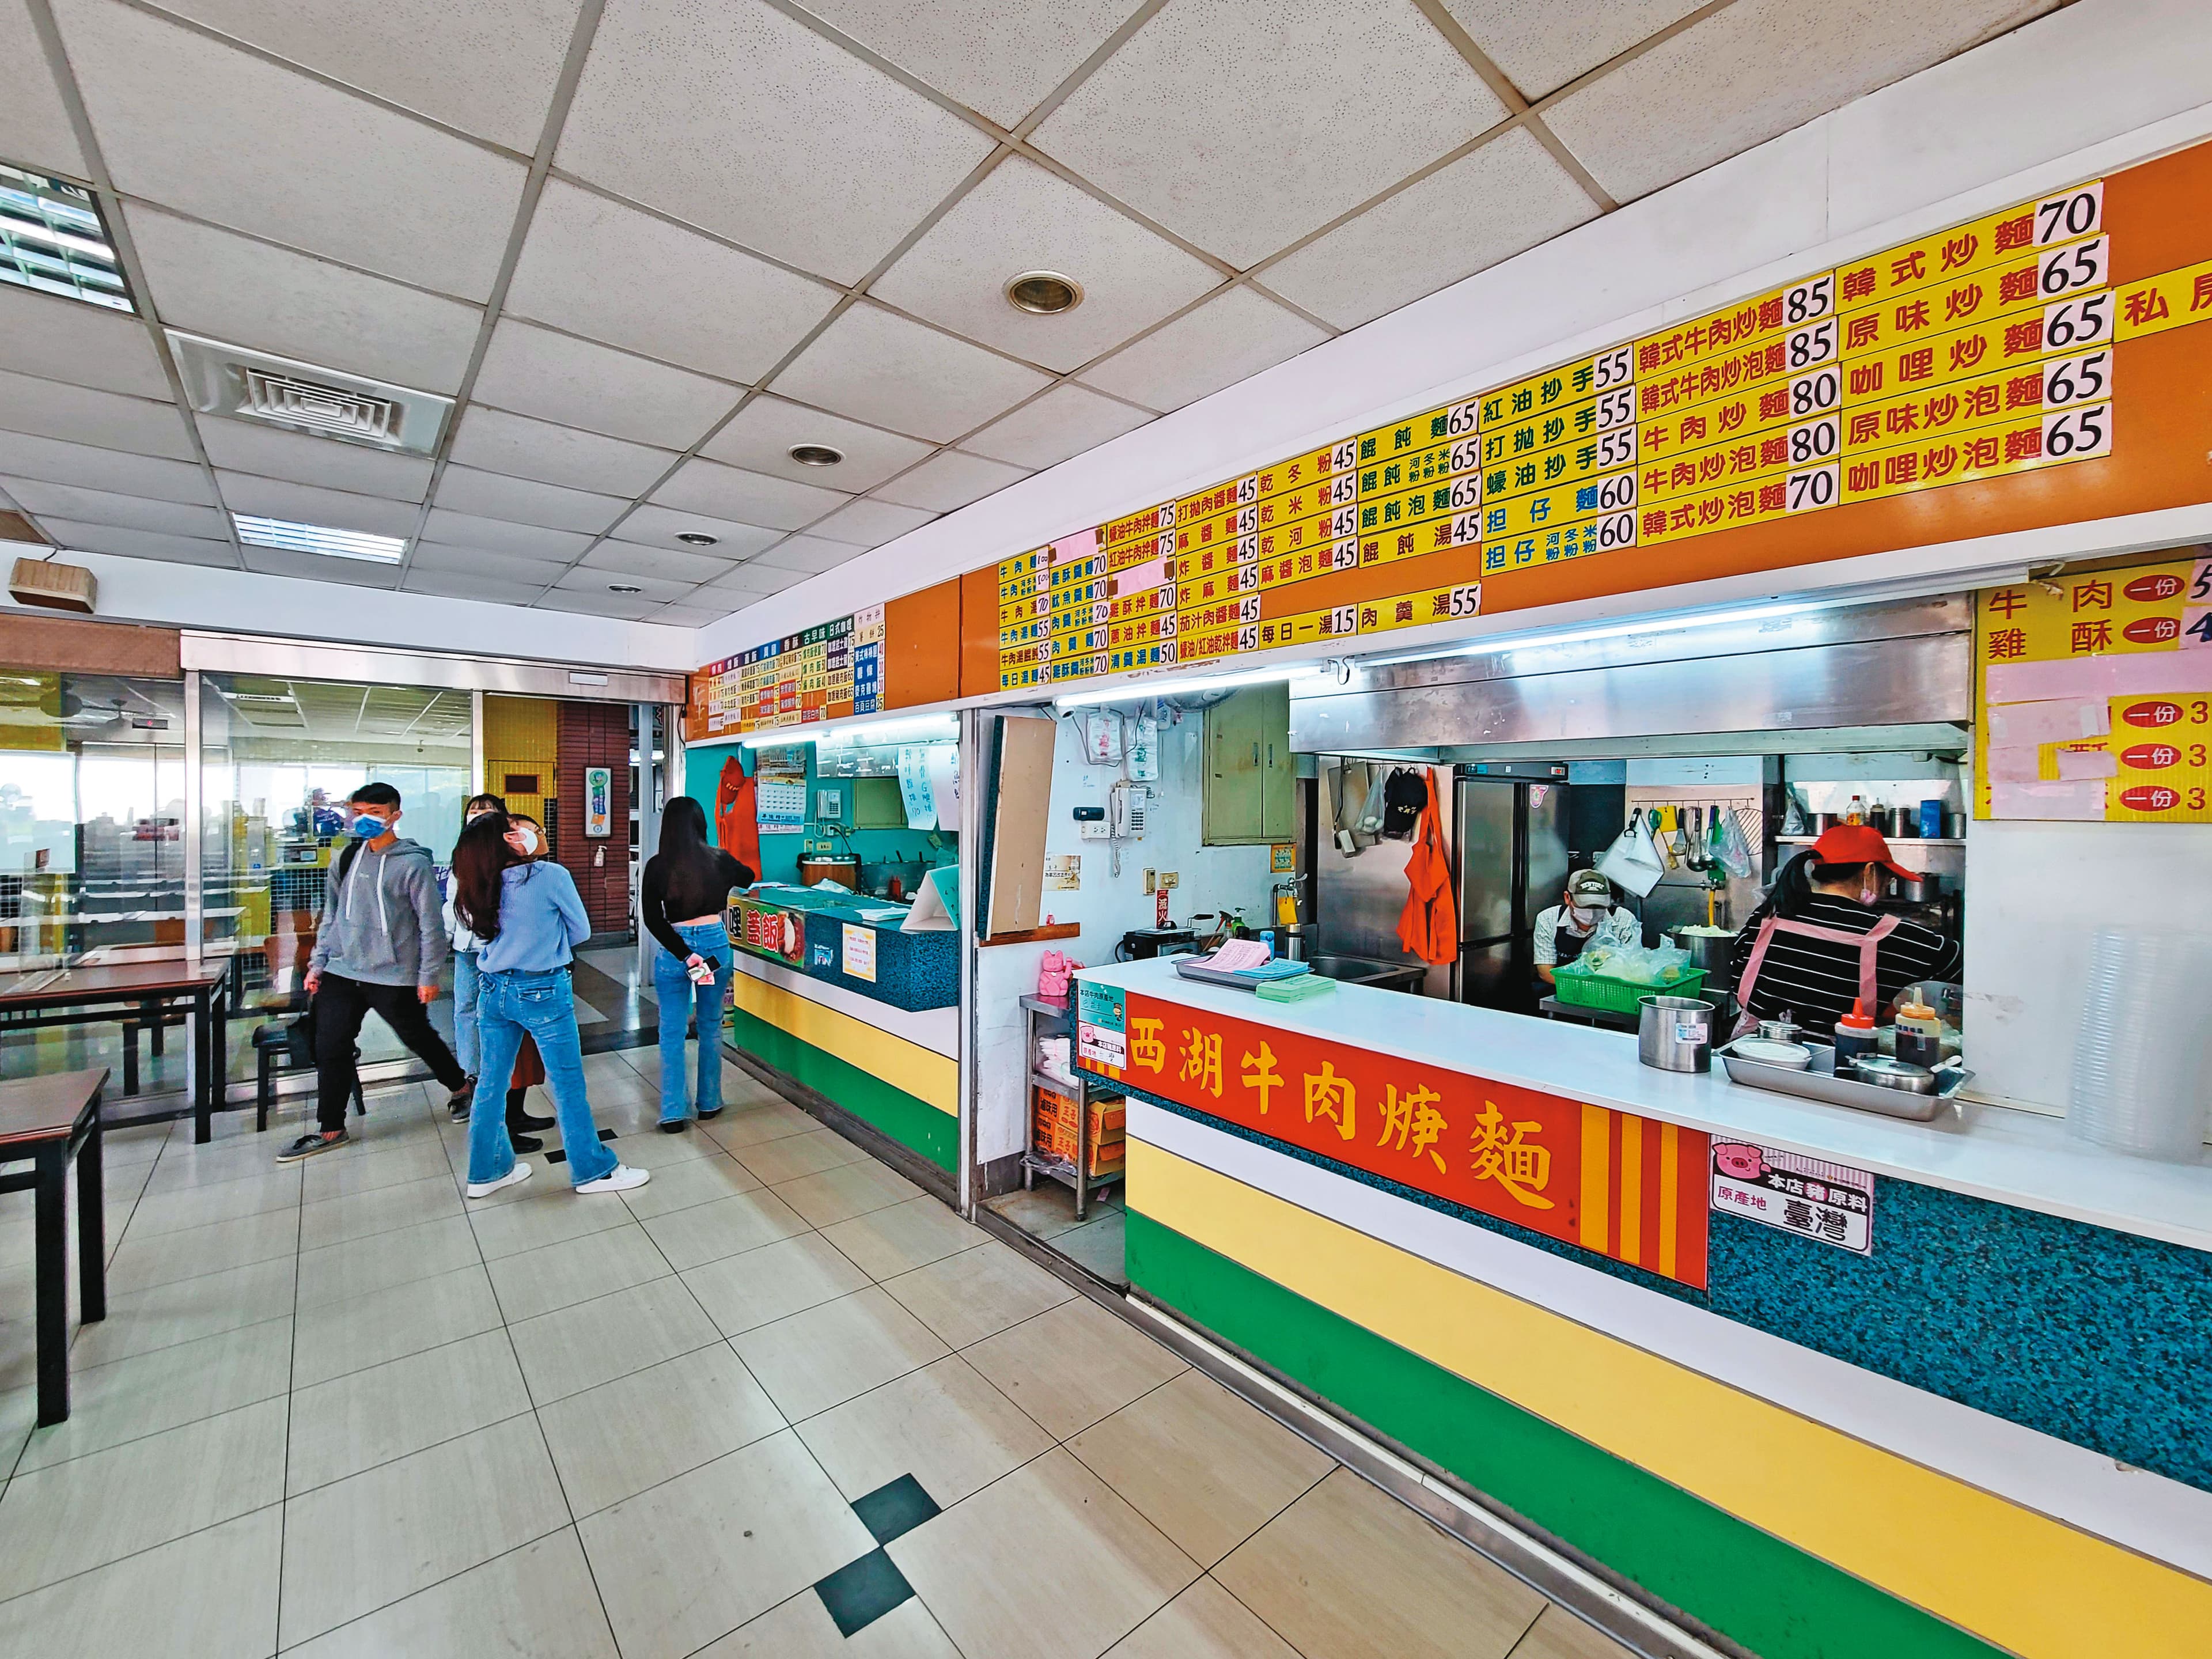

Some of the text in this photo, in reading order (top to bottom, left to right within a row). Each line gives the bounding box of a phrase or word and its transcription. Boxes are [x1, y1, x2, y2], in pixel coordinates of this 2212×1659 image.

[1842, 193, 2095, 302] 韓式炒麵 70
[1846, 239, 2100, 350] 原味炒麵 65
[1639, 277, 1830, 373] 韓式牛肉炒麵 85
[1850, 294, 2107, 395] 咖哩炒麵 65
[1641, 322, 1832, 414] 韓式牛肉炒泡麵 85
[1483, 348, 1628, 424] 紅油抄手 55
[1848, 352, 2105, 446] 原味炒泡麵 65
[1599, 389, 1631, 428] 55
[1643, 373, 1836, 452] 牛肉炒麵 80
[1360, 402, 1476, 461] 餛飩麵 65
[1451, 438, 1478, 471] 65
[1487, 429, 1633, 495] 蠔油抄手 55
[1643, 422, 1835, 494] 牛肉炒泡麵 80
[1848, 406, 2104, 493] 咖哩炒泡麵 65
[1260, 441, 1355, 494] 乾冬粉 45
[1238, 477, 1256, 501] 45
[1261, 475, 1354, 524] 乾米粉 45
[1361, 475, 1478, 529] 餛飩泡麵 65
[1600, 475, 1634, 509] 60
[1643, 471, 1834, 537] 韓式炒泡麵 70
[1160, 503, 1174, 527] 75
[1238, 507, 1256, 532] 45
[1600, 514, 1633, 547] 60
[1160, 531, 1174, 554] 75
[1262, 507, 1355, 555] 乾河粉 45
[1363, 512, 1480, 563] 餛飩湯 45
[1238, 536, 1256, 560] 45
[1261, 540, 1355, 584] 麻醬泡麵 45
[1094, 555, 1106, 574] 70
[1240, 565, 1257, 588] 45
[1038, 597, 1048, 612] 70
[1094, 579, 1106, 599] 70
[1160, 587, 1174, 608] 70
[1450, 586, 1478, 616] 55
[1988, 580, 2112, 619] 牛肉
[2130, 578, 2177, 595] 一份
[1096, 605, 1108, 619] 70
[1241, 597, 1259, 620] 45
[877, 624, 884, 637] 25
[1038, 620, 1049, 637] 55
[1094, 629, 1107, 649] 70
[1161, 614, 1175, 635] 45
[1239, 626, 1257, 649] 45
[1262, 608, 1354, 643] 每日一湯 15
[1988, 619, 2112, 660] 雞酥
[2129, 620, 2176, 638] 一份
[1039, 642, 1049, 661] 55
[1094, 656, 1107, 673] 70
[1161, 643, 1175, 663] 50
[1039, 665, 1050, 683] 45
[820, 707, 825, 718] 70
[877, 698, 882, 710] 25
[2128, 706, 2176, 722] 一份
[2127, 748, 2173, 765] 一份
[2126, 790, 2173, 808] 一份
[1158, 897, 1168, 925] 滅火
[1130, 1016, 1555, 1210] 西湖牛肉焿麵
[1718, 1185, 1767, 1211] 原產地
[1768, 1173, 1868, 1213] 本店豬原料
[1783, 1198, 1848, 1242] 臺灣
